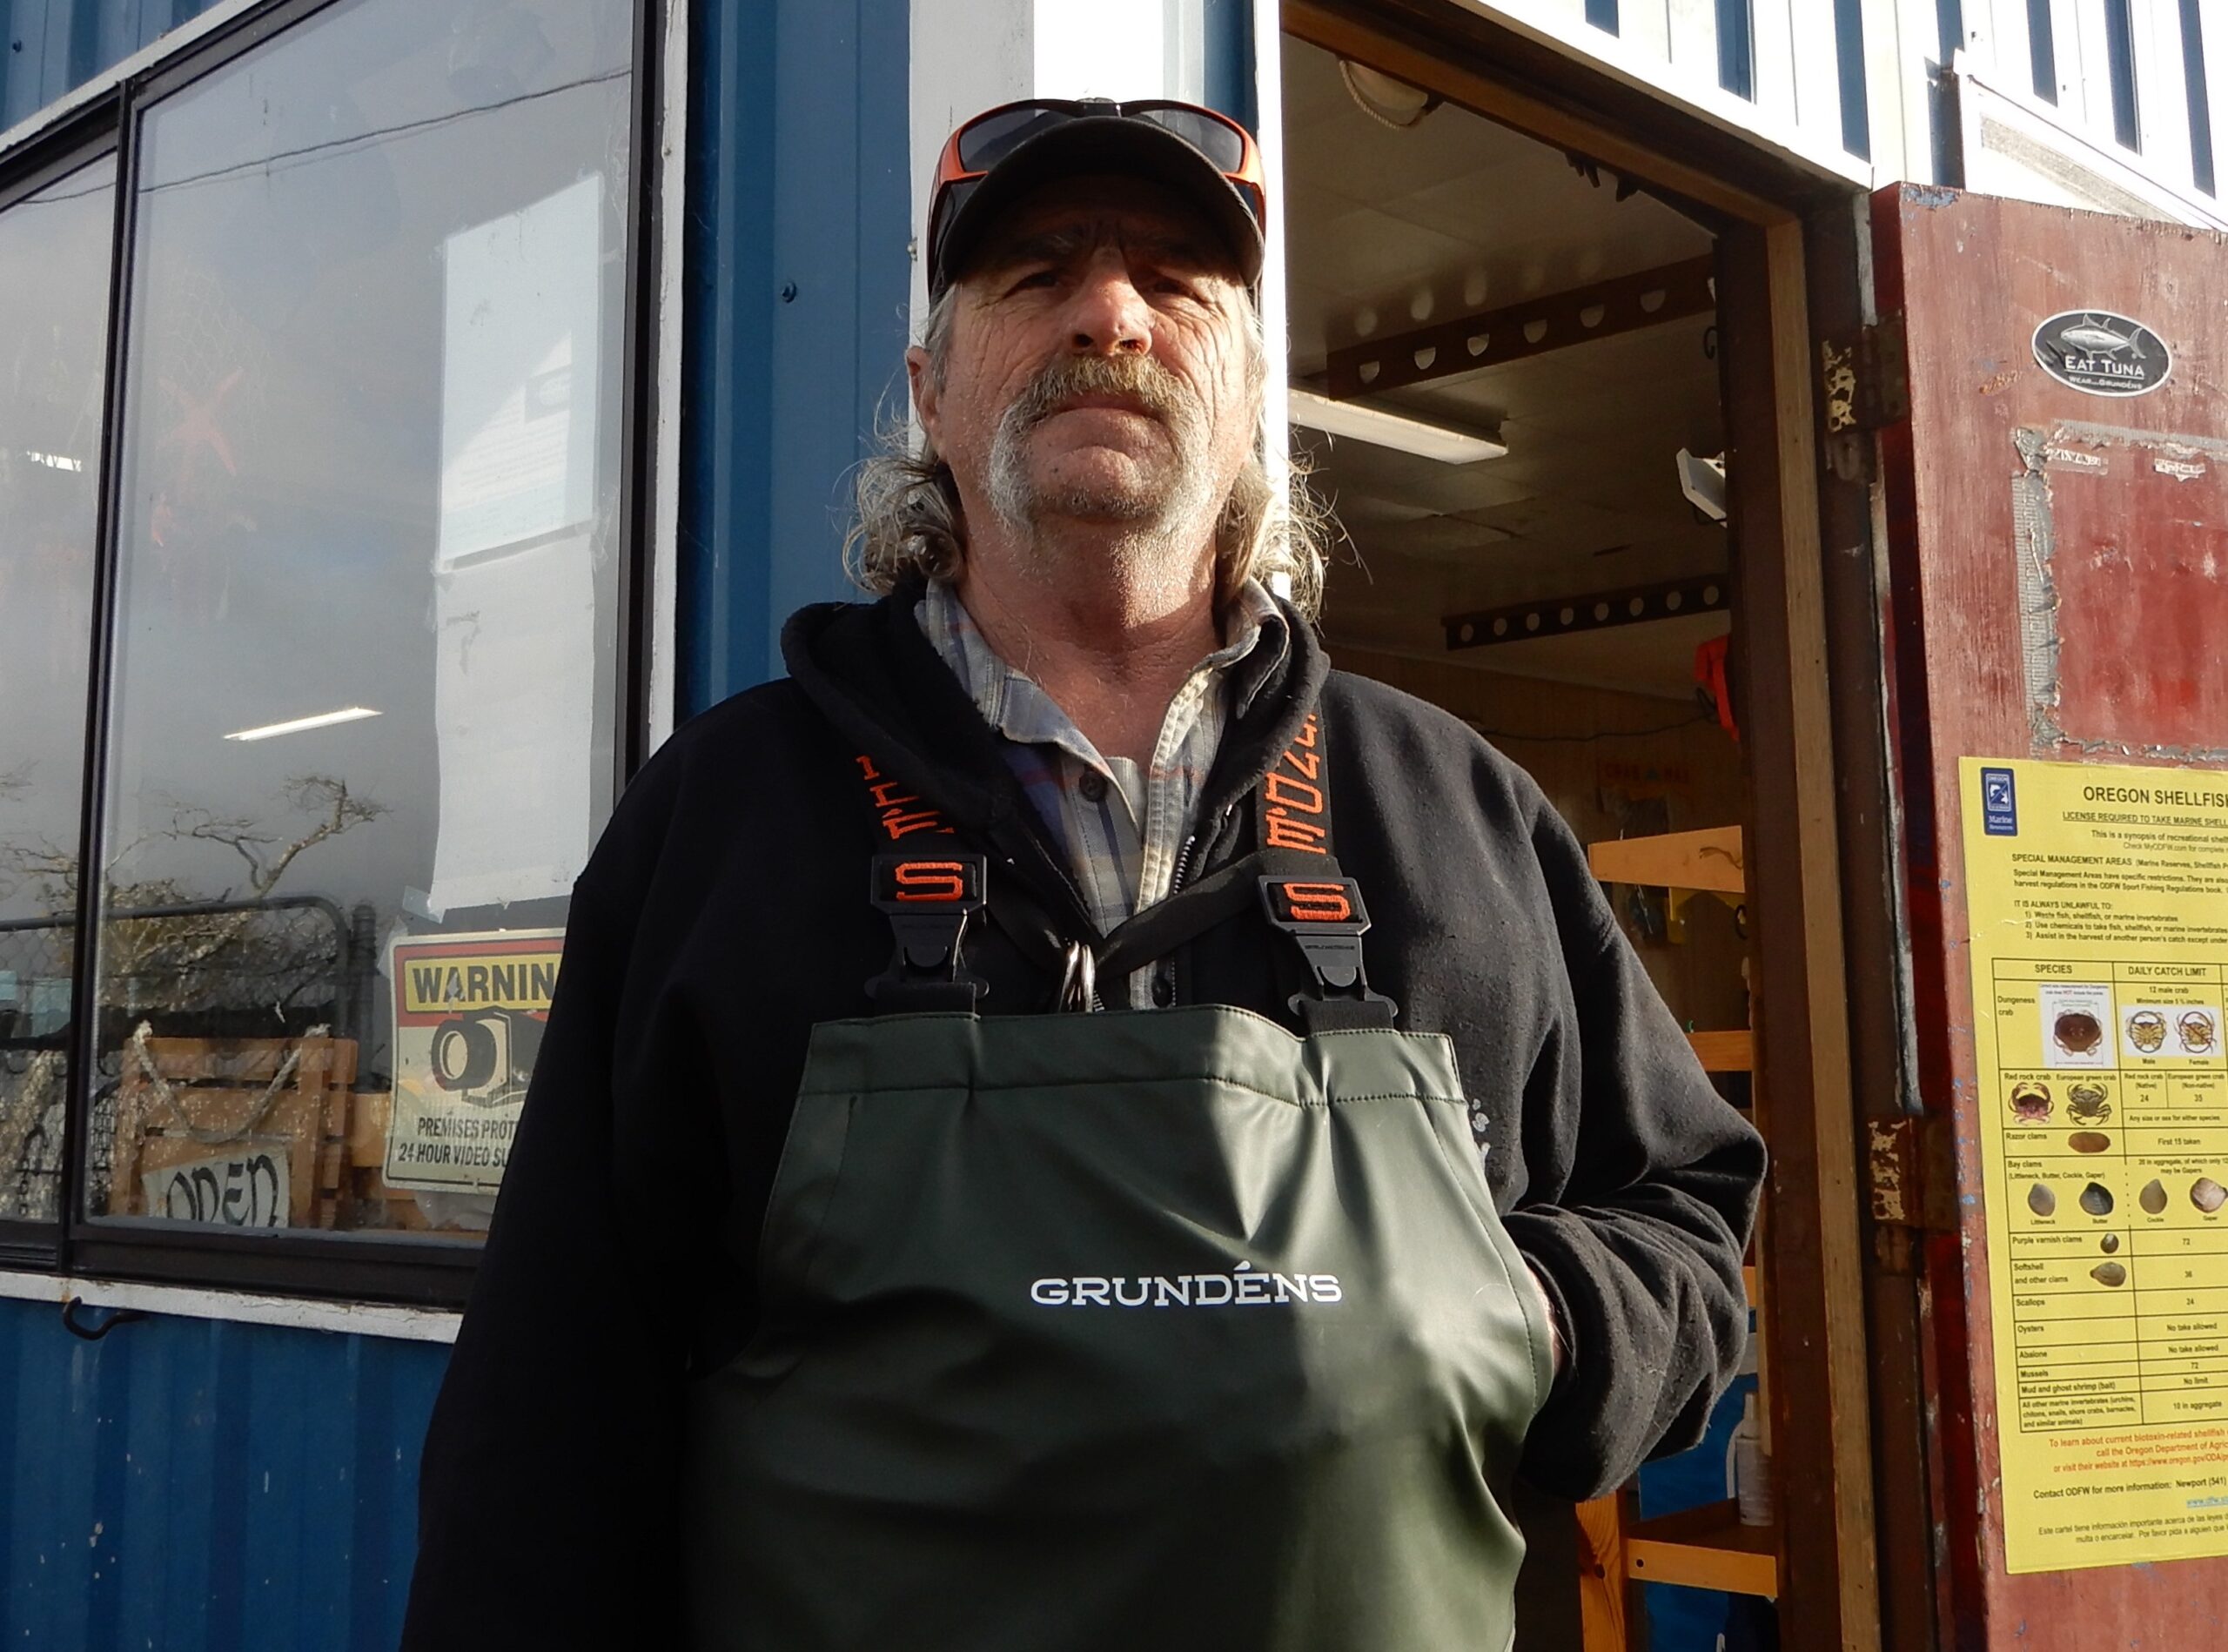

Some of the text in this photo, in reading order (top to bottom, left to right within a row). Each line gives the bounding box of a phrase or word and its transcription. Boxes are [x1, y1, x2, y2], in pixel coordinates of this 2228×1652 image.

[2064, 355, 2145, 378] EAT TUNA
[2084, 787, 2150, 802] OREGON
[2063, 811, 2096, 821] LICENSE
[2097, 813, 2137, 823] REQUIRED
[2140, 815, 2150, 823] TO
[2152, 816, 2171, 824] TAKE
[2173, 816, 2202, 825] MARINE
[2012, 854, 2045, 863] SPECIAL
[2047, 856, 2103, 864] MANAGEMENT
[2035, 964, 2072, 974] SPECIES
[2128, 966, 2206, 977] DAILY CATCH LIMIT
[413, 963, 554, 1004] WARNIN
[1997, 996, 2036, 1004] Dungeness
[418, 1117, 519, 1140] PREMISES PROT
[399, 1142, 510, 1167] 24 HOUR VIDEO SU
[1030, 1259, 1343, 1306] GRUNDÉNS
[2033, 1489, 2064, 1499] Contact
[2065, 1487, 2090, 1496] ODFW
[2176, 1479, 2207, 1487] Newport
